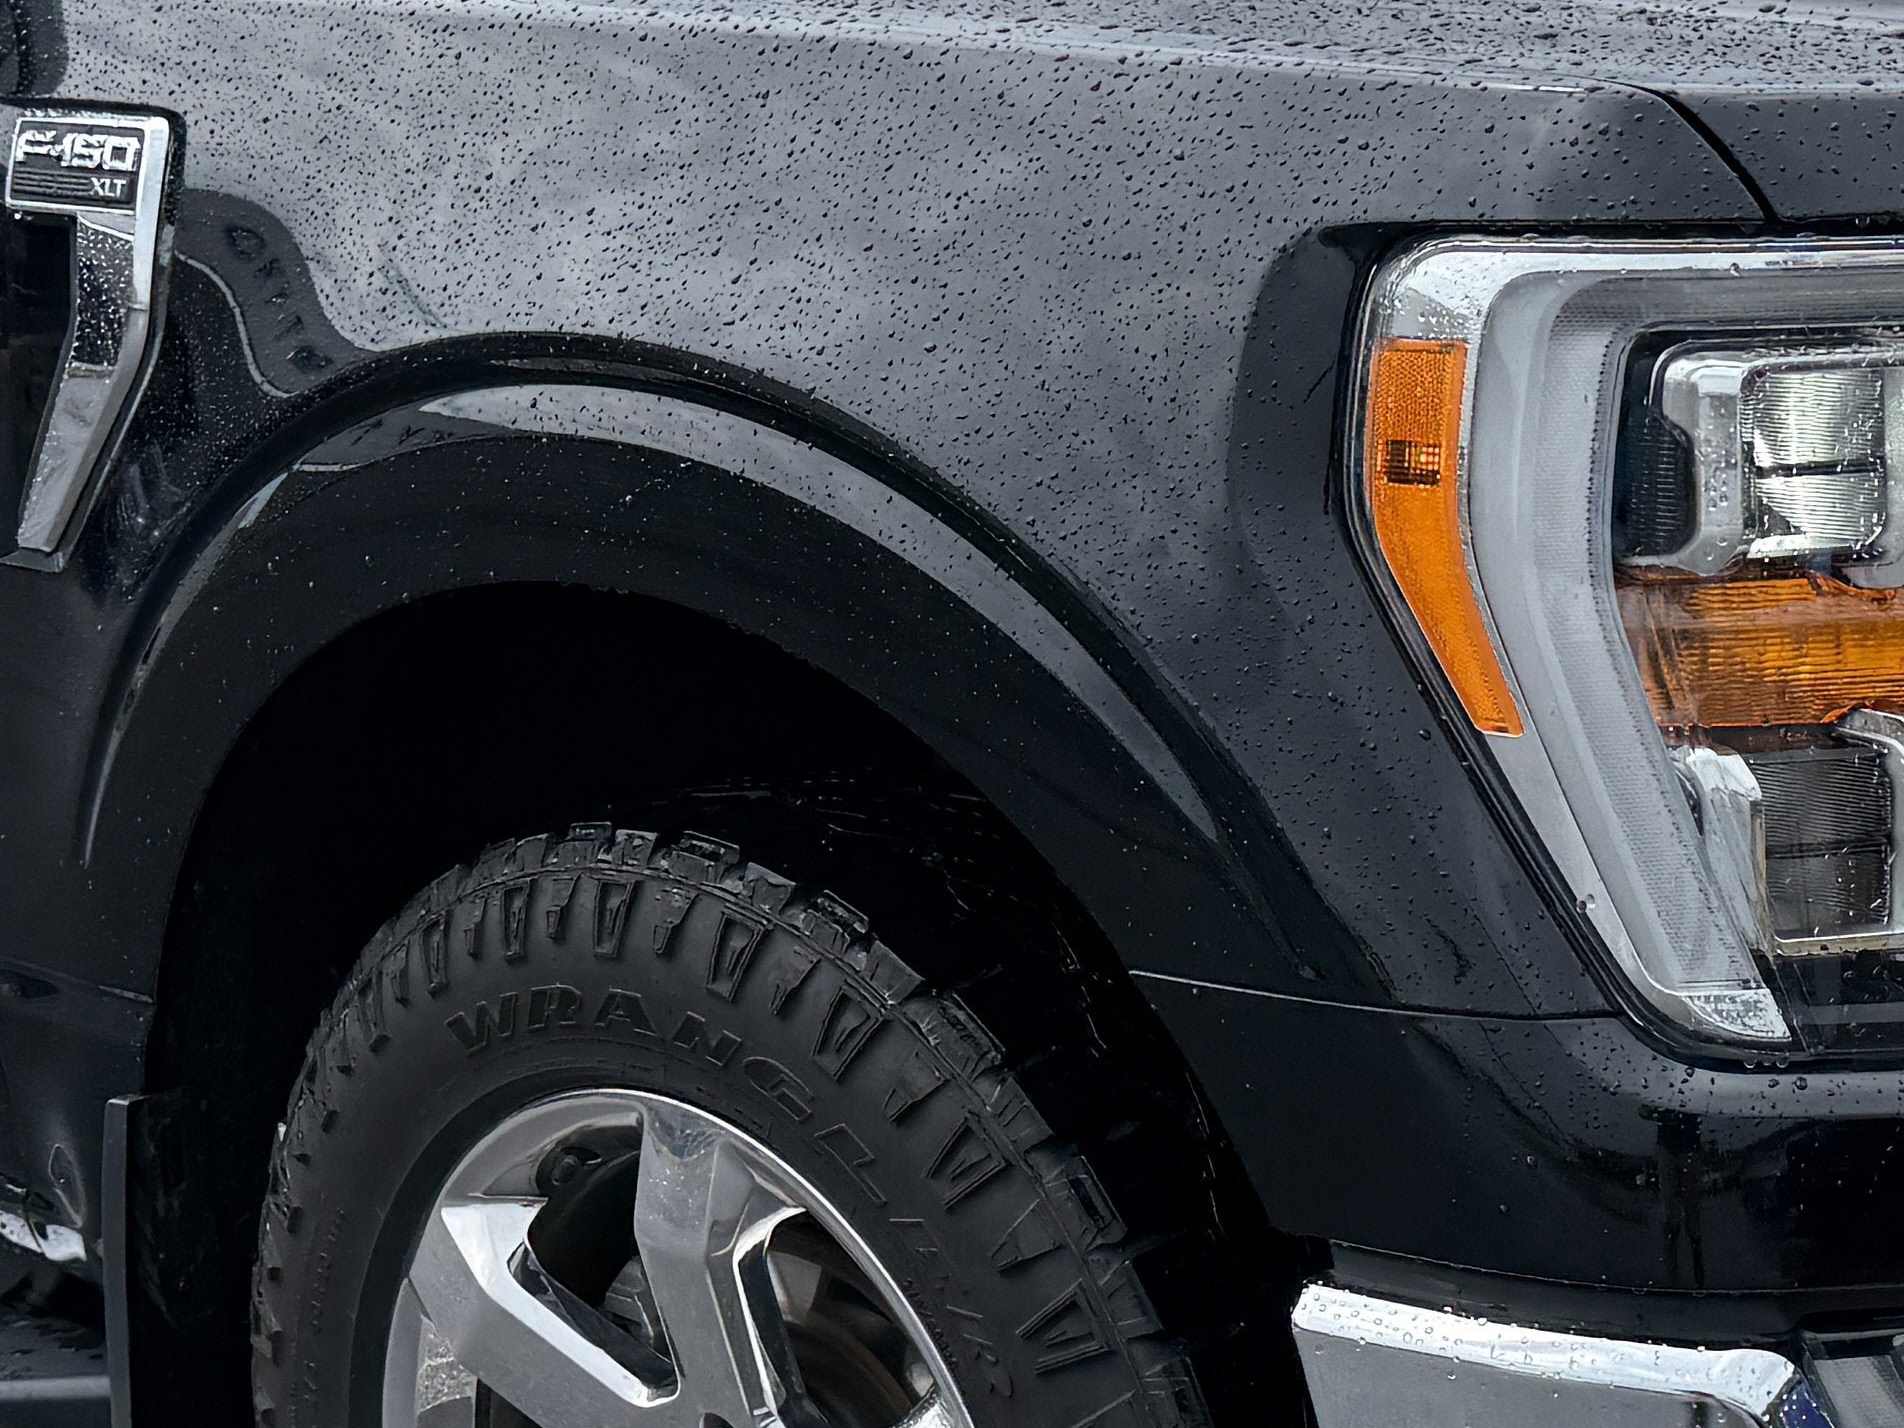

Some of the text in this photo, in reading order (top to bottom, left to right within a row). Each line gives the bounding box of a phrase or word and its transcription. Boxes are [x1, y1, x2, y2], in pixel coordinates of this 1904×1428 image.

[15, 129, 142, 172] F-150
[89, 176, 127, 197] XLT
[444, 982, 1014, 1399] WRANGLER
